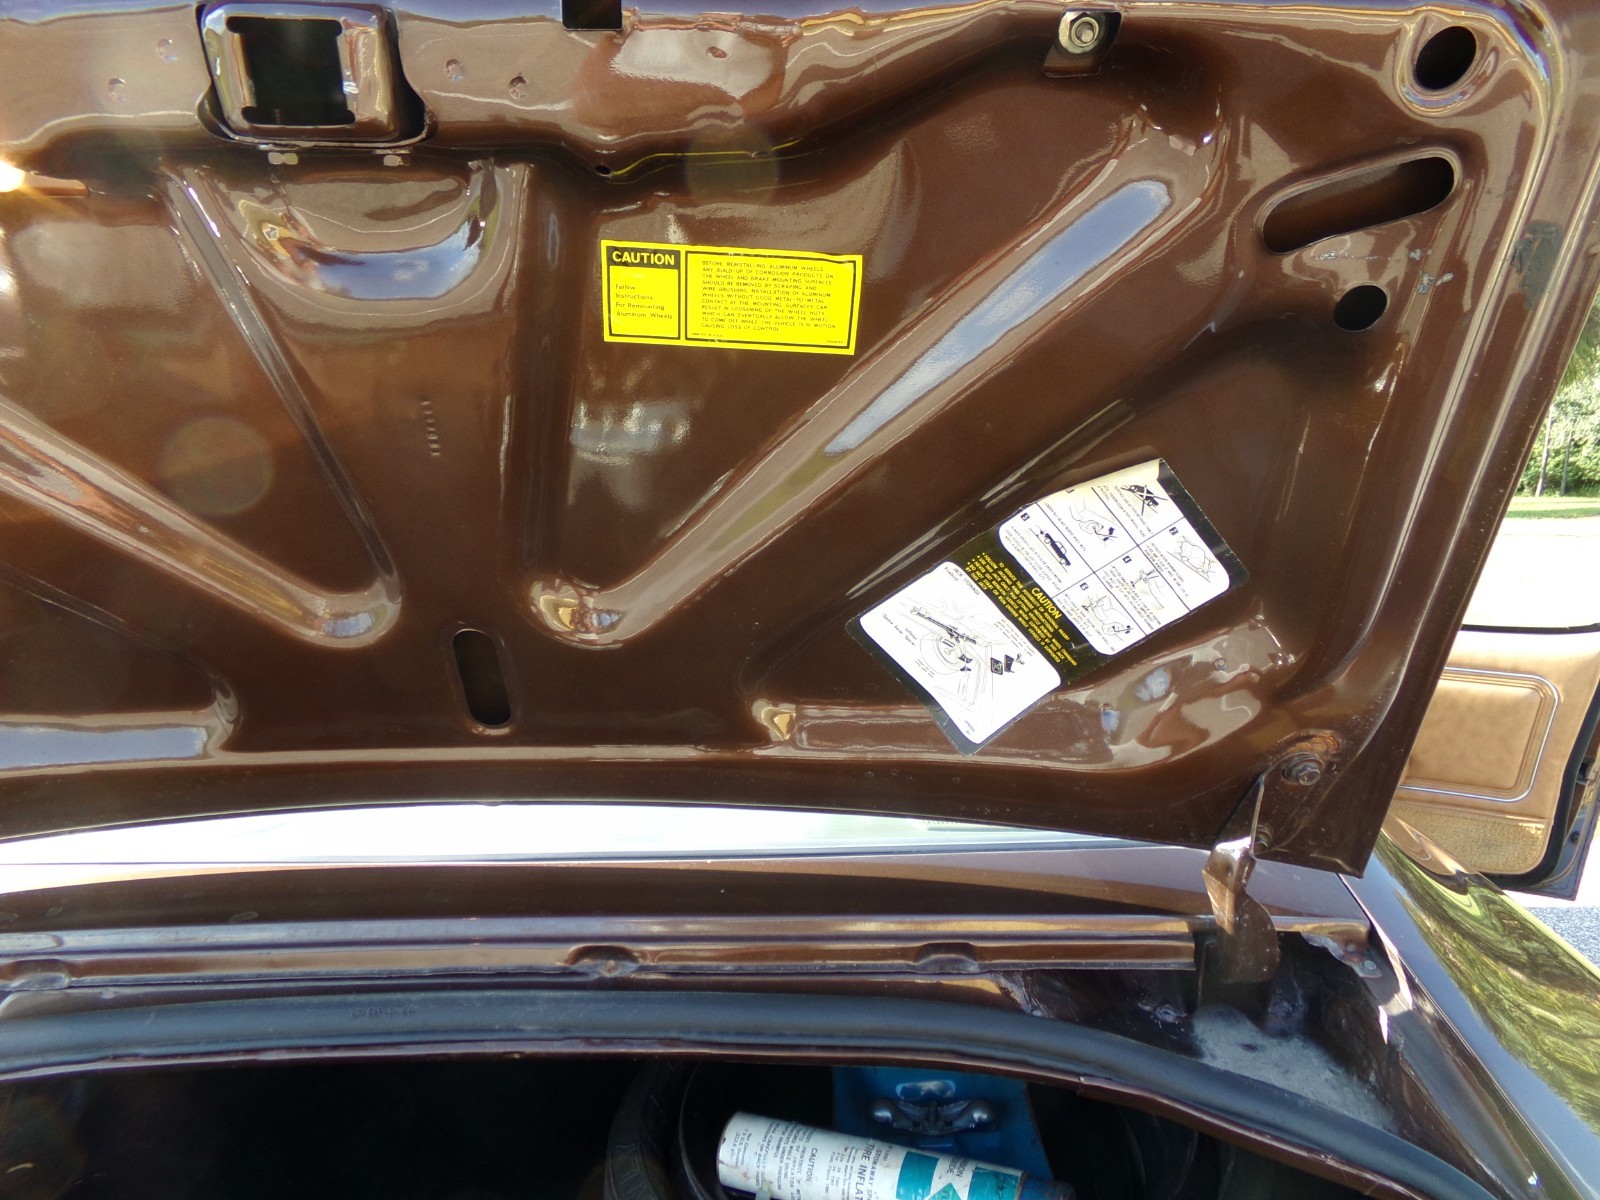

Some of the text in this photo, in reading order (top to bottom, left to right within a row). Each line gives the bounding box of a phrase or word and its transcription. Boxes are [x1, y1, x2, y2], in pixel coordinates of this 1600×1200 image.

[612, 251, 674, 266] CAUTION
[943, 566, 958, 582] Firebird
[952, 566, 980, 596] JACK STOWAGE
[970, 571, 979, 581] THIS
[978, 580, 987, 590] JACK
[983, 554, 998, 570] FOLLOW
[997, 569, 1012, 585] JACKING
[1010, 585, 1020, 595] AND
[969, 563, 976, 571] DO
[974, 570, 983, 579] NOT
[982, 578, 993, 589] START
[992, 588, 999, 596] OR
[997, 595, 1007, 605] RUN
[1027, 627, 1041, 641] VEHICLE
[1043, 644, 1060, 663] SUPPORTED
[973, 560, 985, 573] NEVER
[984, 572, 992, 580] GET
[991, 580, 1006, 596] BENEATH
[1005, 595, 1018, 609] VEHICLE
[1018, 609, 1029, 621] WHEN
[1028, 620, 1045, 639] SUPPORTED
[1049, 643, 1057, 651] THIS
[1055, 650, 1065, 660] JACK
[978, 557, 986, 565] USE
[984, 564, 992, 572] THIS
[991, 571, 1001, 581] JACK
[1015, 598, 1028, 612] LIFTING
[1027, 611, 1040, 625] VEHICLE
[1039, 624, 1052, 638] DURING
[1051, 638, 1062, 649] WHEEL
[1003, 567, 1016, 581] REDUCE
[1015, 580, 1023, 589] THE
[1021, 588, 1041, 609] POSSIBILITY
[1043, 611, 1059, 629] PERSONAL
[1029, 585, 1062, 620] CAUTION
[760, 1135, 773, 1168] CAREFULLY
[773, 1136, 783, 1158] HARMFUL
[796, 1146, 805, 1173] FROSTBITE
[861, 1143, 875, 1161] TIRE
[789, 1156, 797, 1188] INFLATOR
[867, 1149, 881, 1185] STOWAWAY
